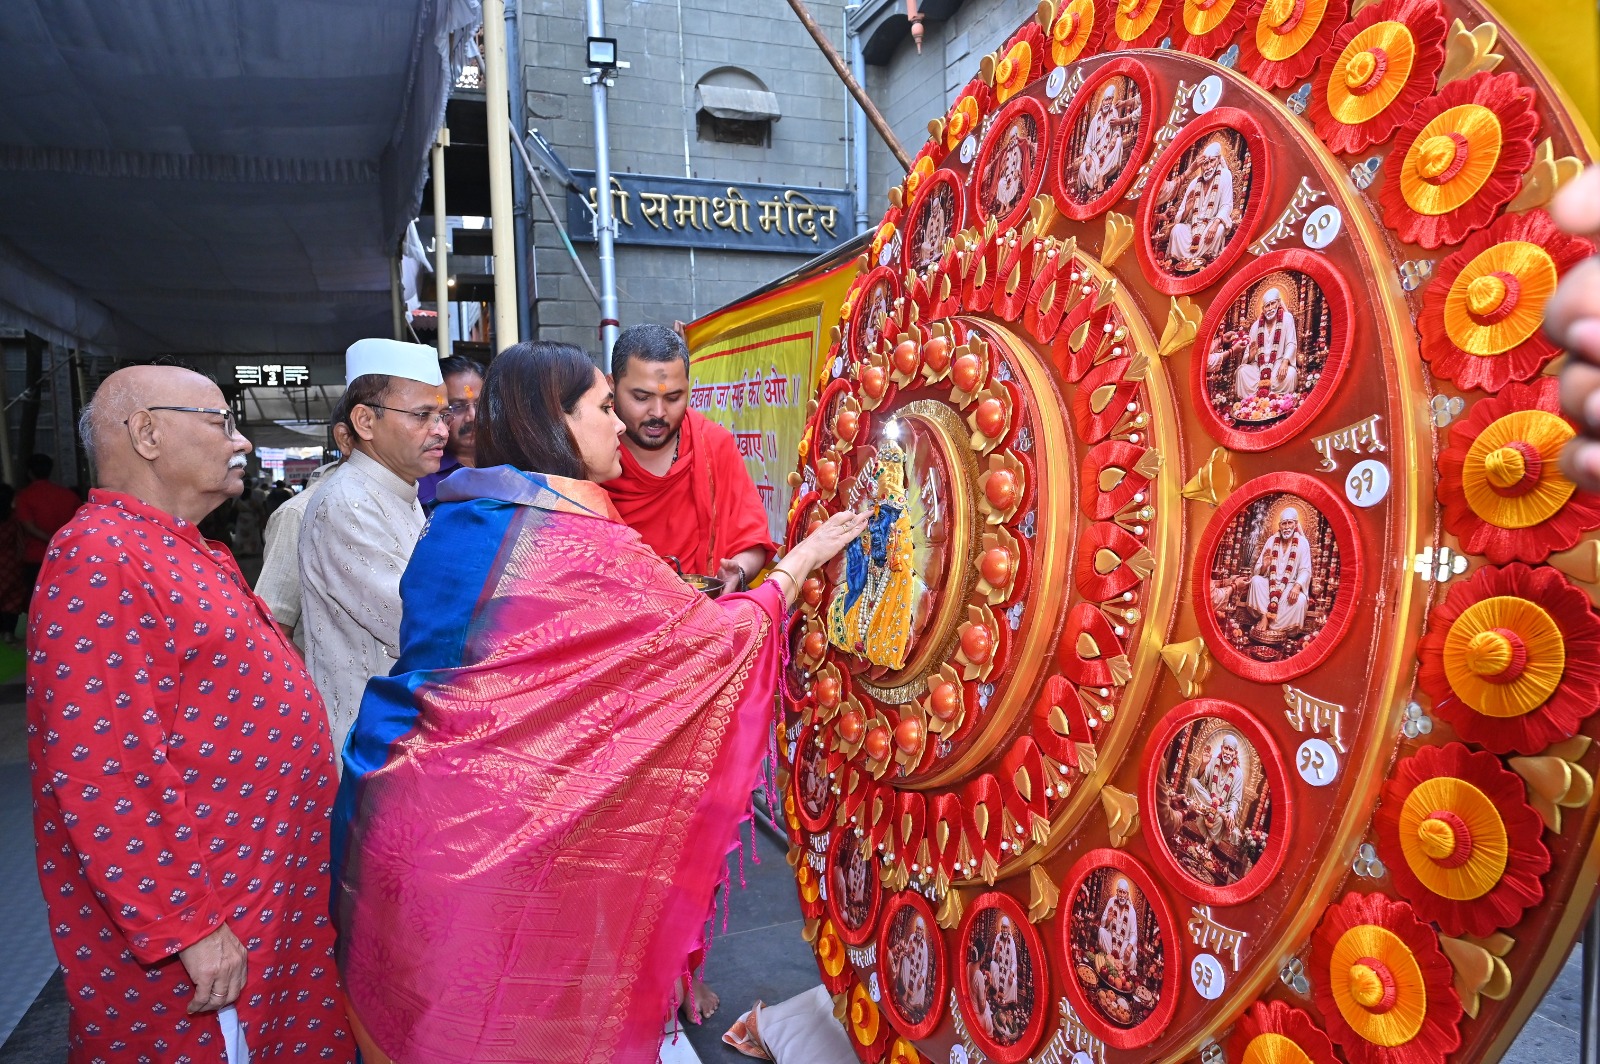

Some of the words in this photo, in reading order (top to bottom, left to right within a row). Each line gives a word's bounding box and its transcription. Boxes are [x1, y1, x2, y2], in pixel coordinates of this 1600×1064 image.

[639, 186, 753, 233] समाधी
[758, 189, 838, 244] मंदिर
[1306, 213, 1331, 243] १०
[268, 372, 276, 381] 3
[716, 385, 731, 408] जा
[748, 371, 762, 406] की
[764, 367, 788, 405] ओर
[1350, 468, 1373, 501] ११
[1300, 747, 1324, 779] १२
[1195, 962, 1213, 995] १३
